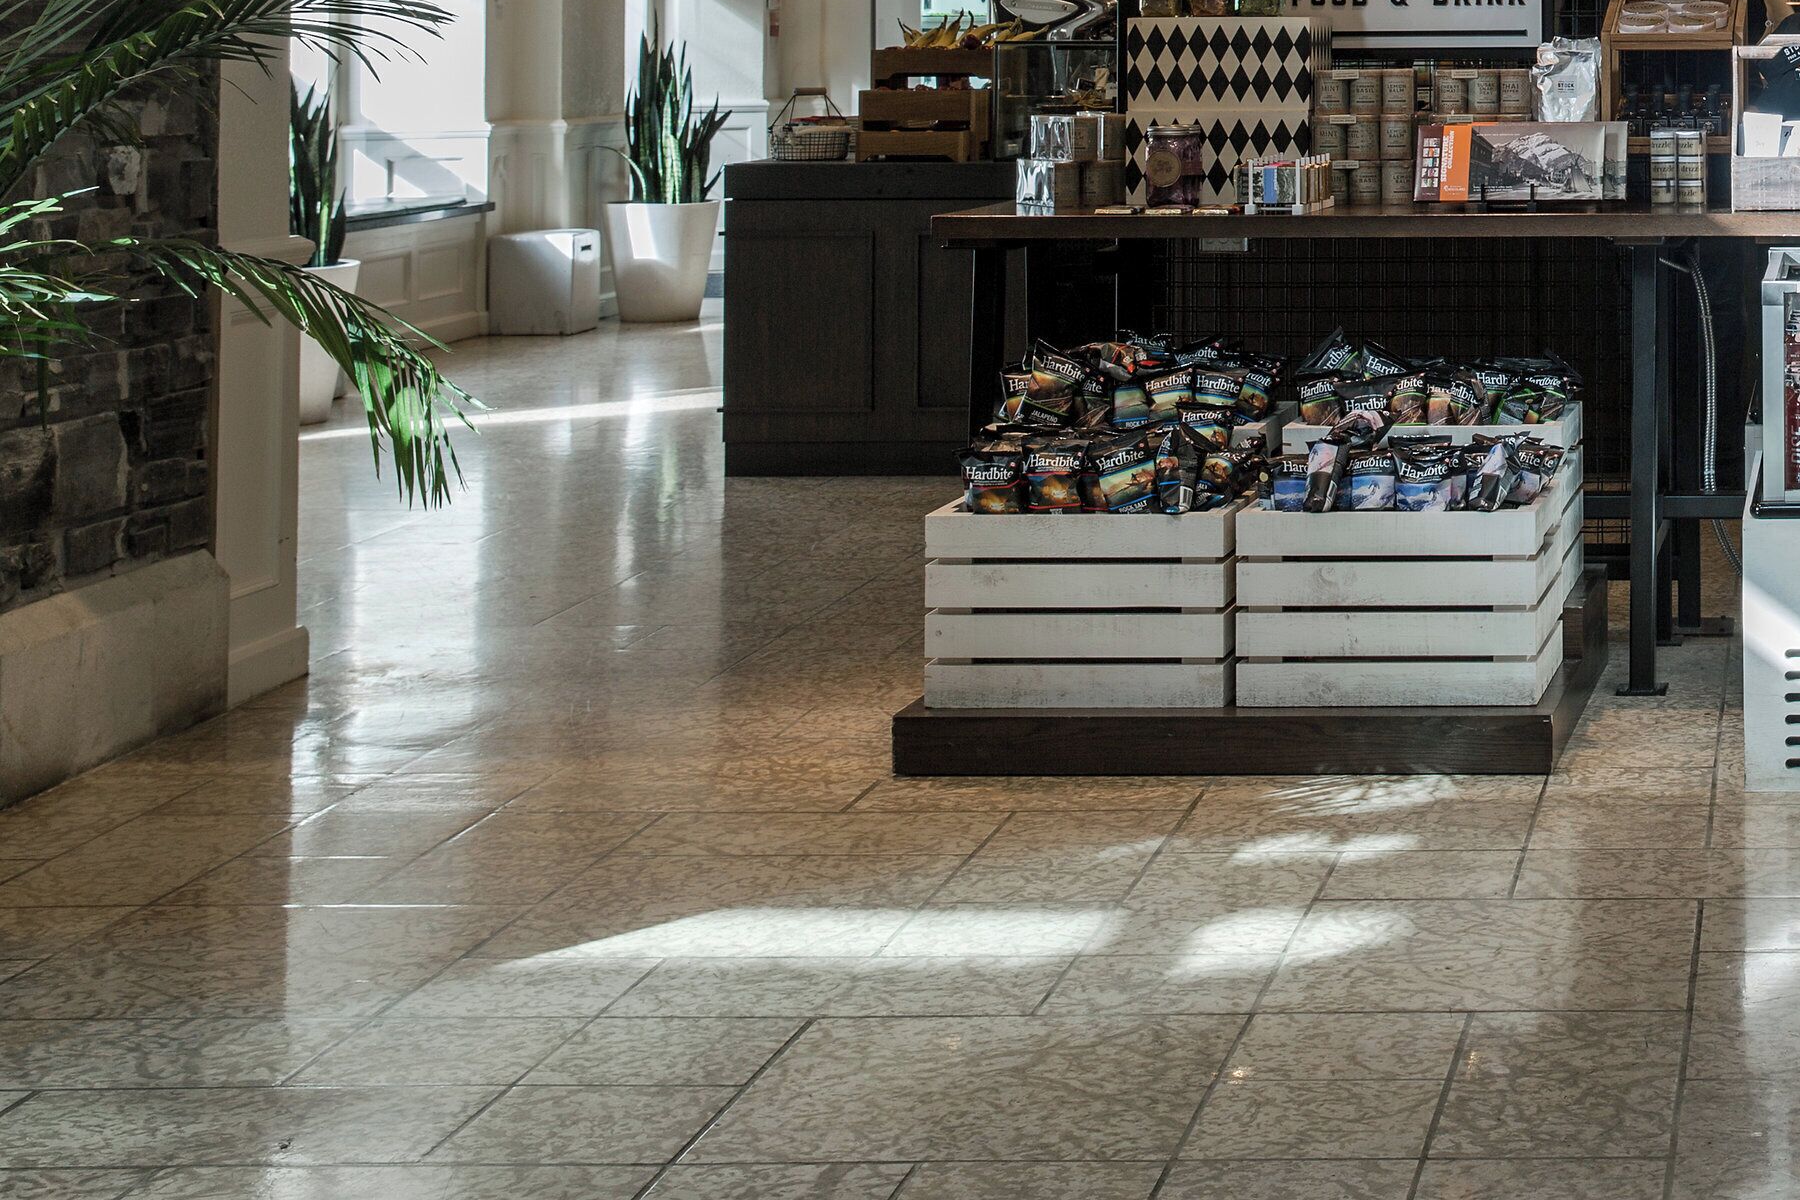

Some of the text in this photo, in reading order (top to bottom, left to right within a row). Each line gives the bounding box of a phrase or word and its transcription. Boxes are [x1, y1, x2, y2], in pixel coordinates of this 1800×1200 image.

[1440, 135, 1449, 183] SIGNATURE
[1040, 354, 1085, 383] Hardbite
[1145, 374, 1192, 391] Hardbite
[1197, 375, 1240, 394] Hardbite
[1031, 408, 1059, 423] JALAPEÑO
[1029, 453, 1080, 470] Hardbite
[1096, 450, 1146, 472] Hardbite
[1399, 461, 1449, 479] Hardbite
[965, 466, 1014, 482] Hardbite
